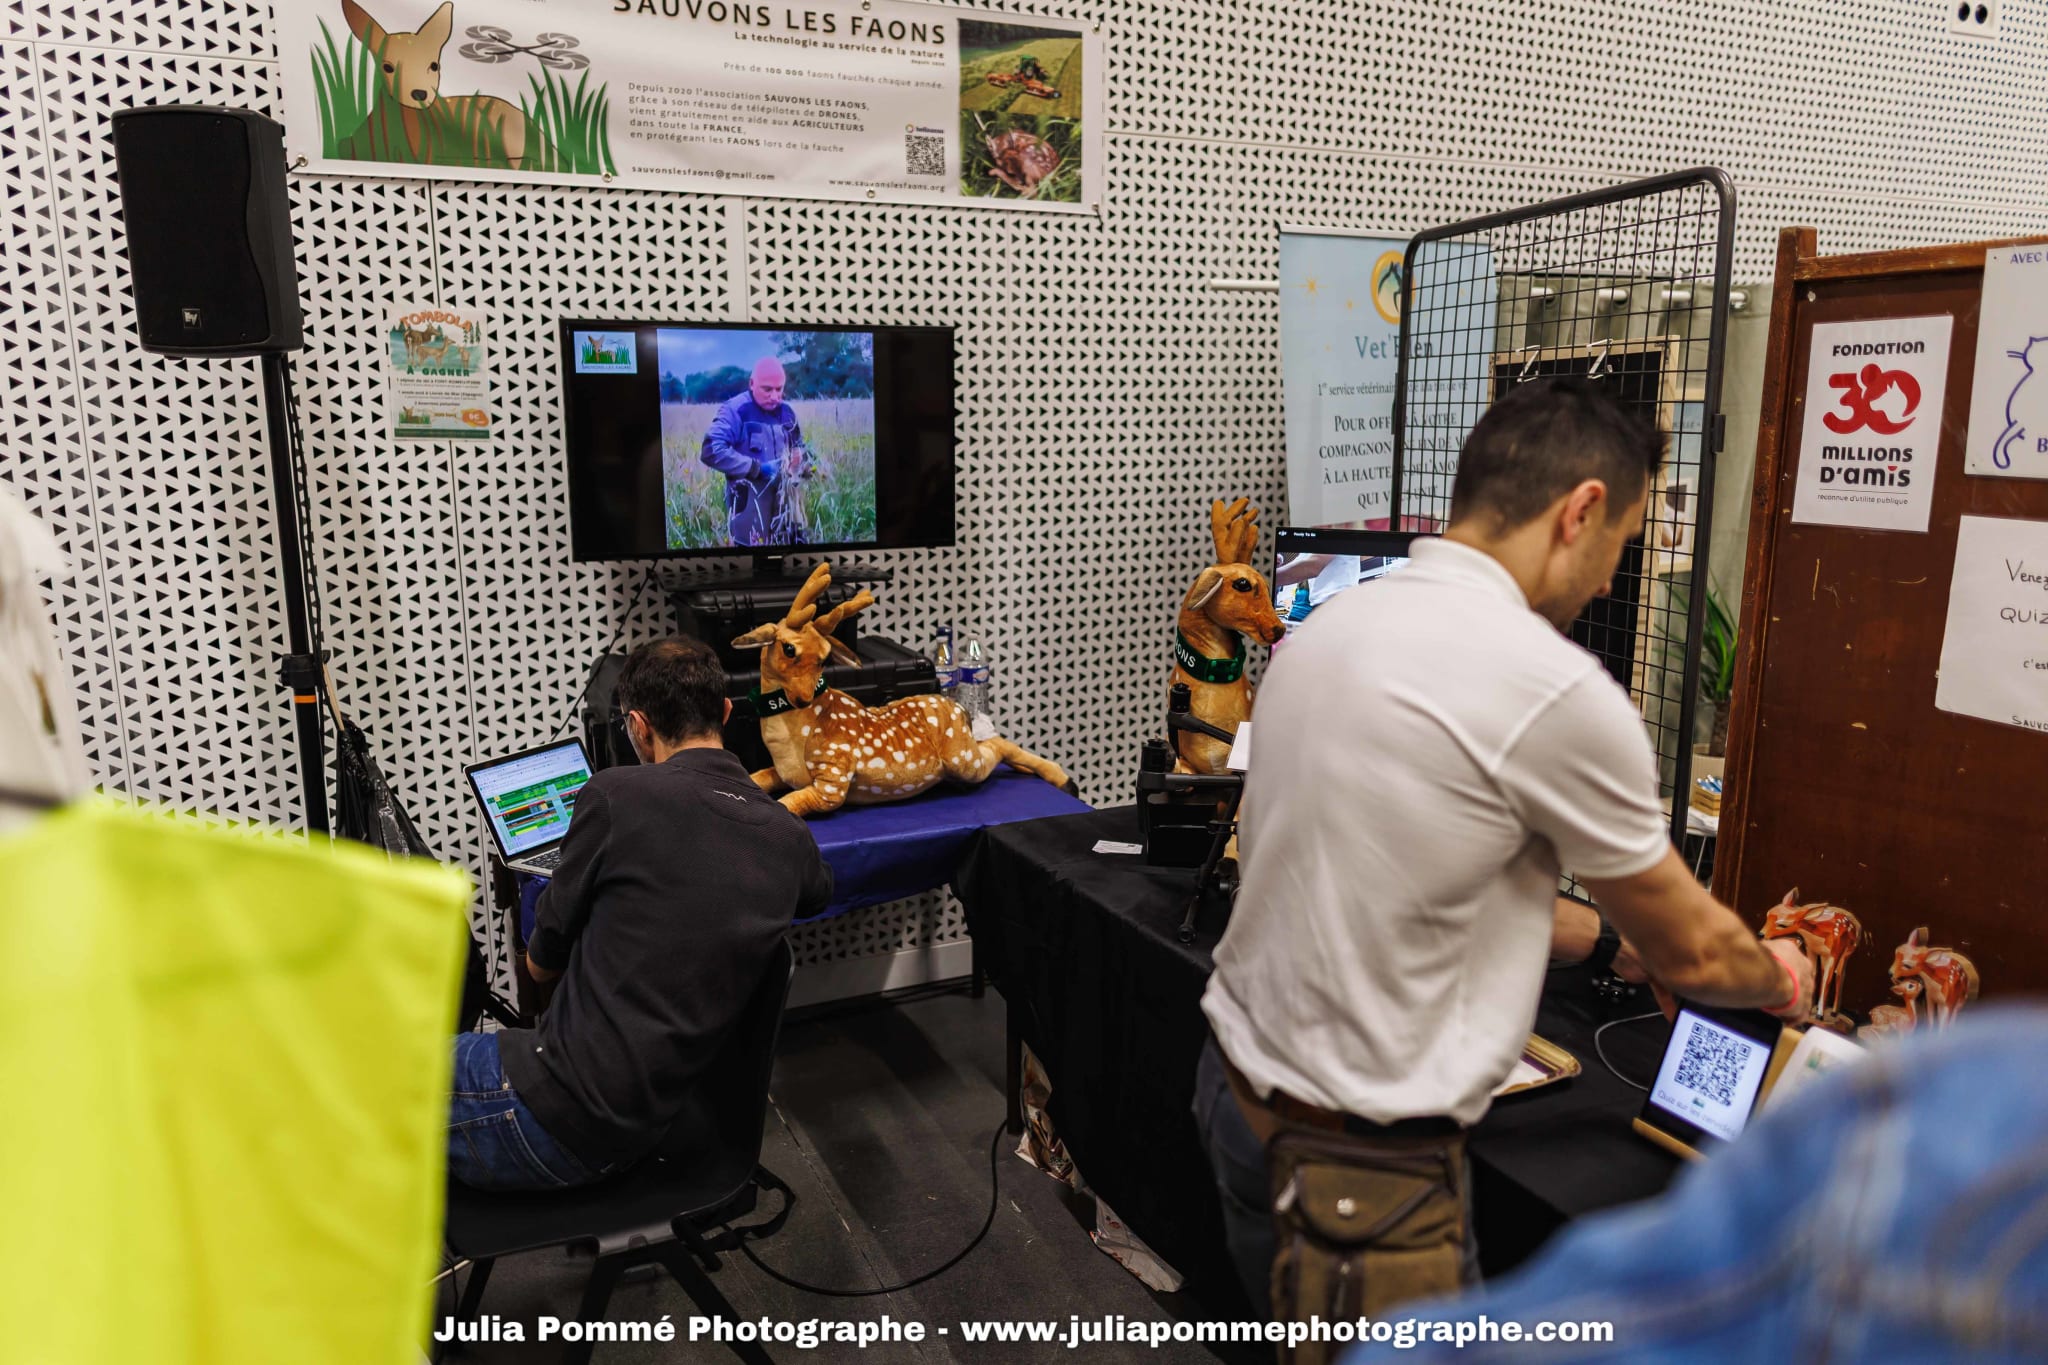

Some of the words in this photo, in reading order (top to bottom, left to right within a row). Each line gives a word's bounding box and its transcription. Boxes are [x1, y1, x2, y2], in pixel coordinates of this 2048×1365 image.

[614, 0, 771, 27] SAUVONS
[786, 9, 836, 33] LES
[851, 16, 945, 44] FAONS
[735, 31, 747, 40] La
[751, 33, 818, 49] technologie
[839, 42, 877, 53] service
[881, 46, 893, 55] de
[897, 47, 906, 56] la
[910, 50, 945, 59] nature
[724, 61, 746, 71] Près
[750, 64, 761, 73] de
[807, 69, 834, 80] faons
[838, 71, 875, 83] fauchés
[878, 77, 912, 88] chaque
[628, 82, 664, 93] Depuis
[668, 87, 692, 95] 2020
[696, 87, 761, 101] l'association
[764, 94, 812, 105] SAUVONS
[814, 98, 832, 107] LES
[835, 100, 870, 111] FAONS,
[629, 95, 658, 105] grâce
[662, 96, 668, 105] à
[671, 99, 690, 107] son
[693, 99, 727, 110] réseau
[731, 103, 743, 111] de
[746, 104, 800, 116] télépilotes
[803, 109, 815, 117] de
[819, 110, 861, 121] DRONES,
[629, 107, 657, 116] vient
[660, 108, 728, 122] gratuitement
[732, 115, 744, 123] en
[747, 116, 768, 125] aide
[772, 119, 789, 127] aux
[792, 119, 865, 132] AGRICULTEURS
[630, 118, 655, 128] dans
[658, 120, 687, 130] toute
[690, 122, 700, 131] la
[703, 123, 747, 135] FRANCE,
[630, 131, 643, 139] en
[646, 131, 705, 144] protégeant
[709, 135, 724, 144] les
[727, 137, 761, 147] FAONS
[763, 140, 782, 148] lors
[786, 141, 797, 149] de
[800, 142, 809, 151] la
[812, 143, 845, 153] fauche
[631, 165, 776, 181] sauvonslesfaons@gmail.com
[829, 179, 945, 193] www.sauvonslesfaons.org
[2010, 251, 2042, 264] AVEC
[399, 310, 473, 333] TOMBOLA
[1832, 341, 1925, 357] FONDATION
[422, 367, 470, 377] GAGNER
[1329, 384, 1355, 396] service
[1356, 381, 1396, 395] vétérinair
[1319, 441, 1392, 459] COMPAGNON
[1821, 445, 1913, 463] MILLIONS
[1323, 467, 1332, 485] À
[1334, 469, 1348, 484] LA
[1357, 491, 1380, 510] QUI
[1817, 494, 1849, 502] reconnue
[1876, 497, 1909, 507] publique
